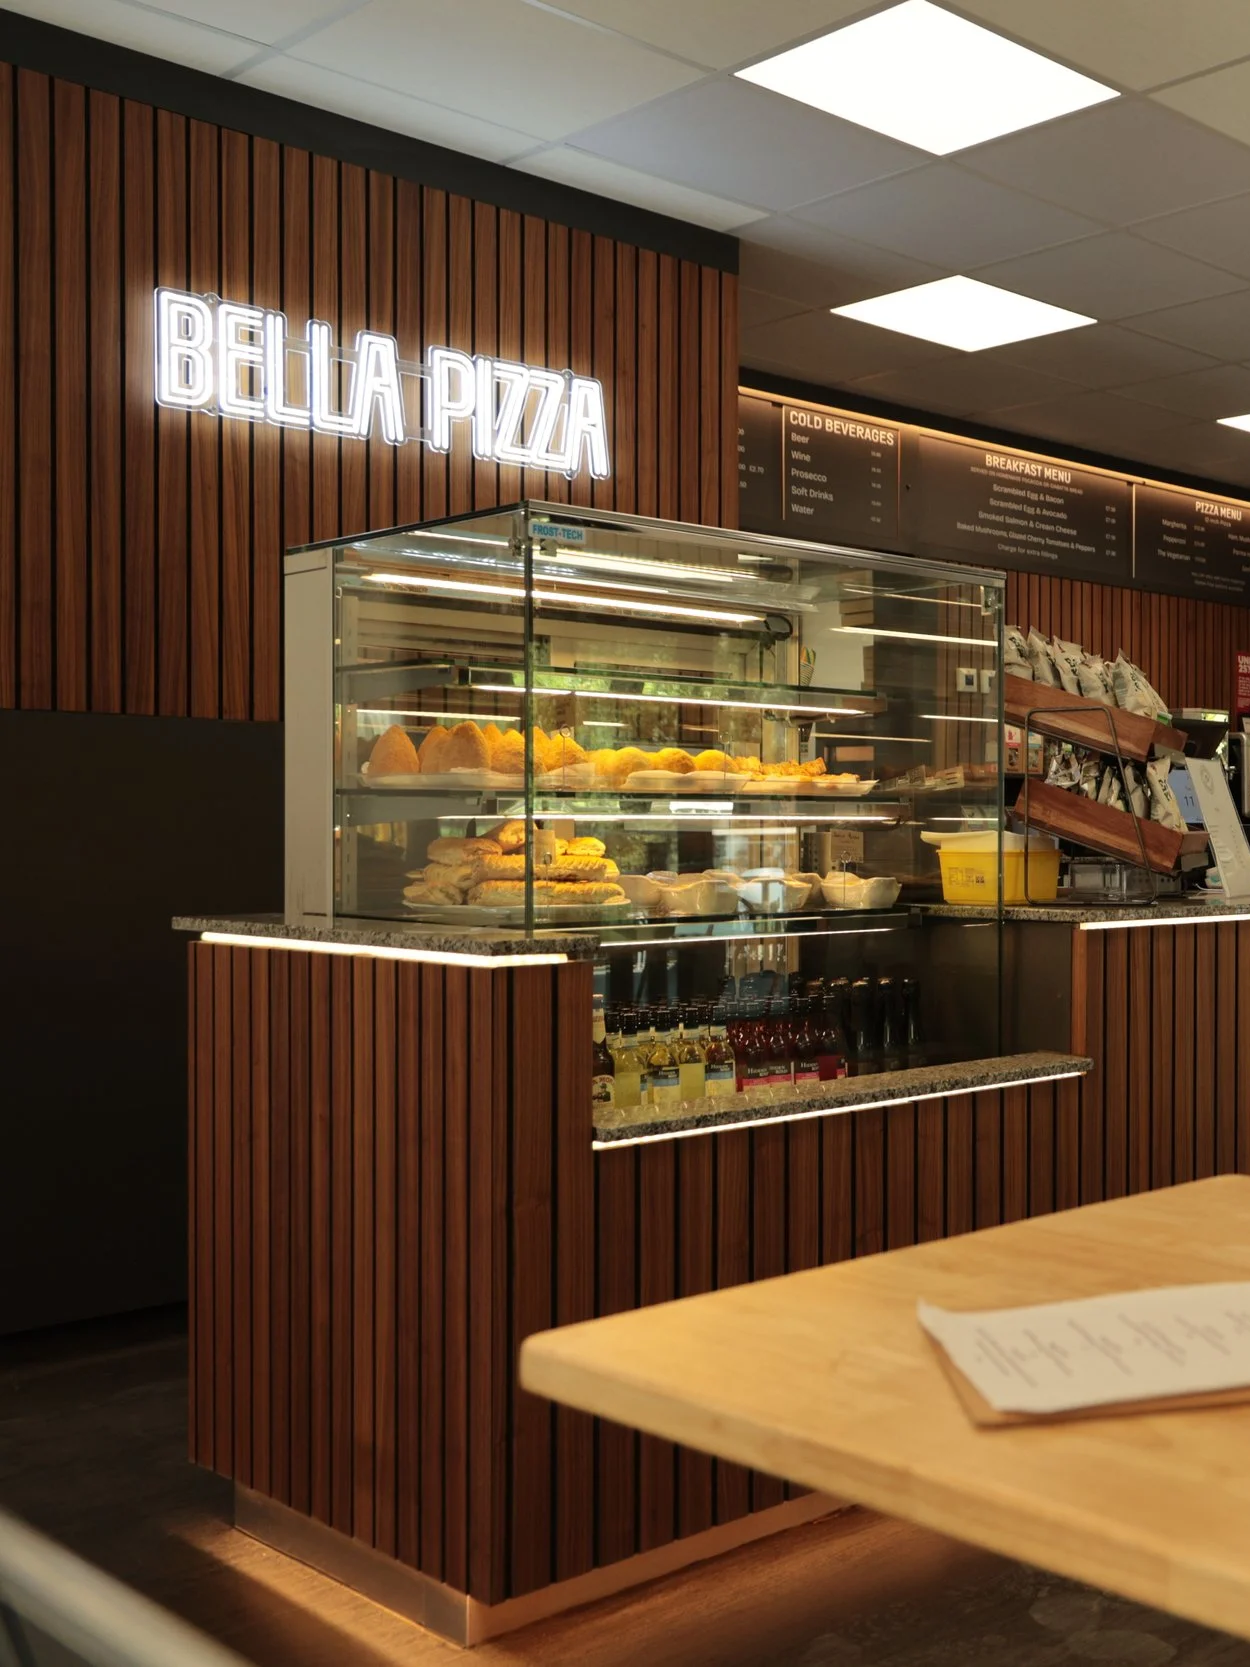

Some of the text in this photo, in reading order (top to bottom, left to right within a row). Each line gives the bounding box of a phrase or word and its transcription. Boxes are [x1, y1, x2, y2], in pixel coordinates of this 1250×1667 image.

[156, 287, 610, 479] BELLA PIZZA
[790, 411, 895, 446] COLD BEVERAGES
[791, 432, 810, 444] Beer
[791, 450, 812, 462] Wine
[791, 467, 828, 483] Prosecco
[986, 454, 1072, 484] BREAKFAST MENU
[791, 485, 834, 502] Soft Drinks
[993, 484, 1026, 496] Scrambled
[1027, 491, 1039, 502] Egg
[1045, 494, 1064, 505] Bacon
[791, 503, 814, 516] Water
[990, 498, 1023, 511] Scrambled
[1024, 505, 1035, 516] Egg
[1042, 508, 1068, 520] Avocado
[1196, 501, 1242, 522] PIZZA MENU
[978, 511, 1005, 522] Smoked
[1006, 515, 1028, 527] Salmon
[1035, 521, 1055, 531] Cream
[1056, 525, 1078, 536] Cheese
[1162, 519, 1187, 531] Margherita
[533, 525, 583, 541] FROST-TECH
[957, 522, 975, 533] Baked
[976, 525, 1008, 538] Mushrooms,
[1027, 534, 1045, 545] Cherry
[1046, 538, 1069, 549] Tomatoes
[1076, 543, 1096, 553] Peppers
[1027, 549, 1040, 557] extra
[1158, 549, 1166, 558] The
